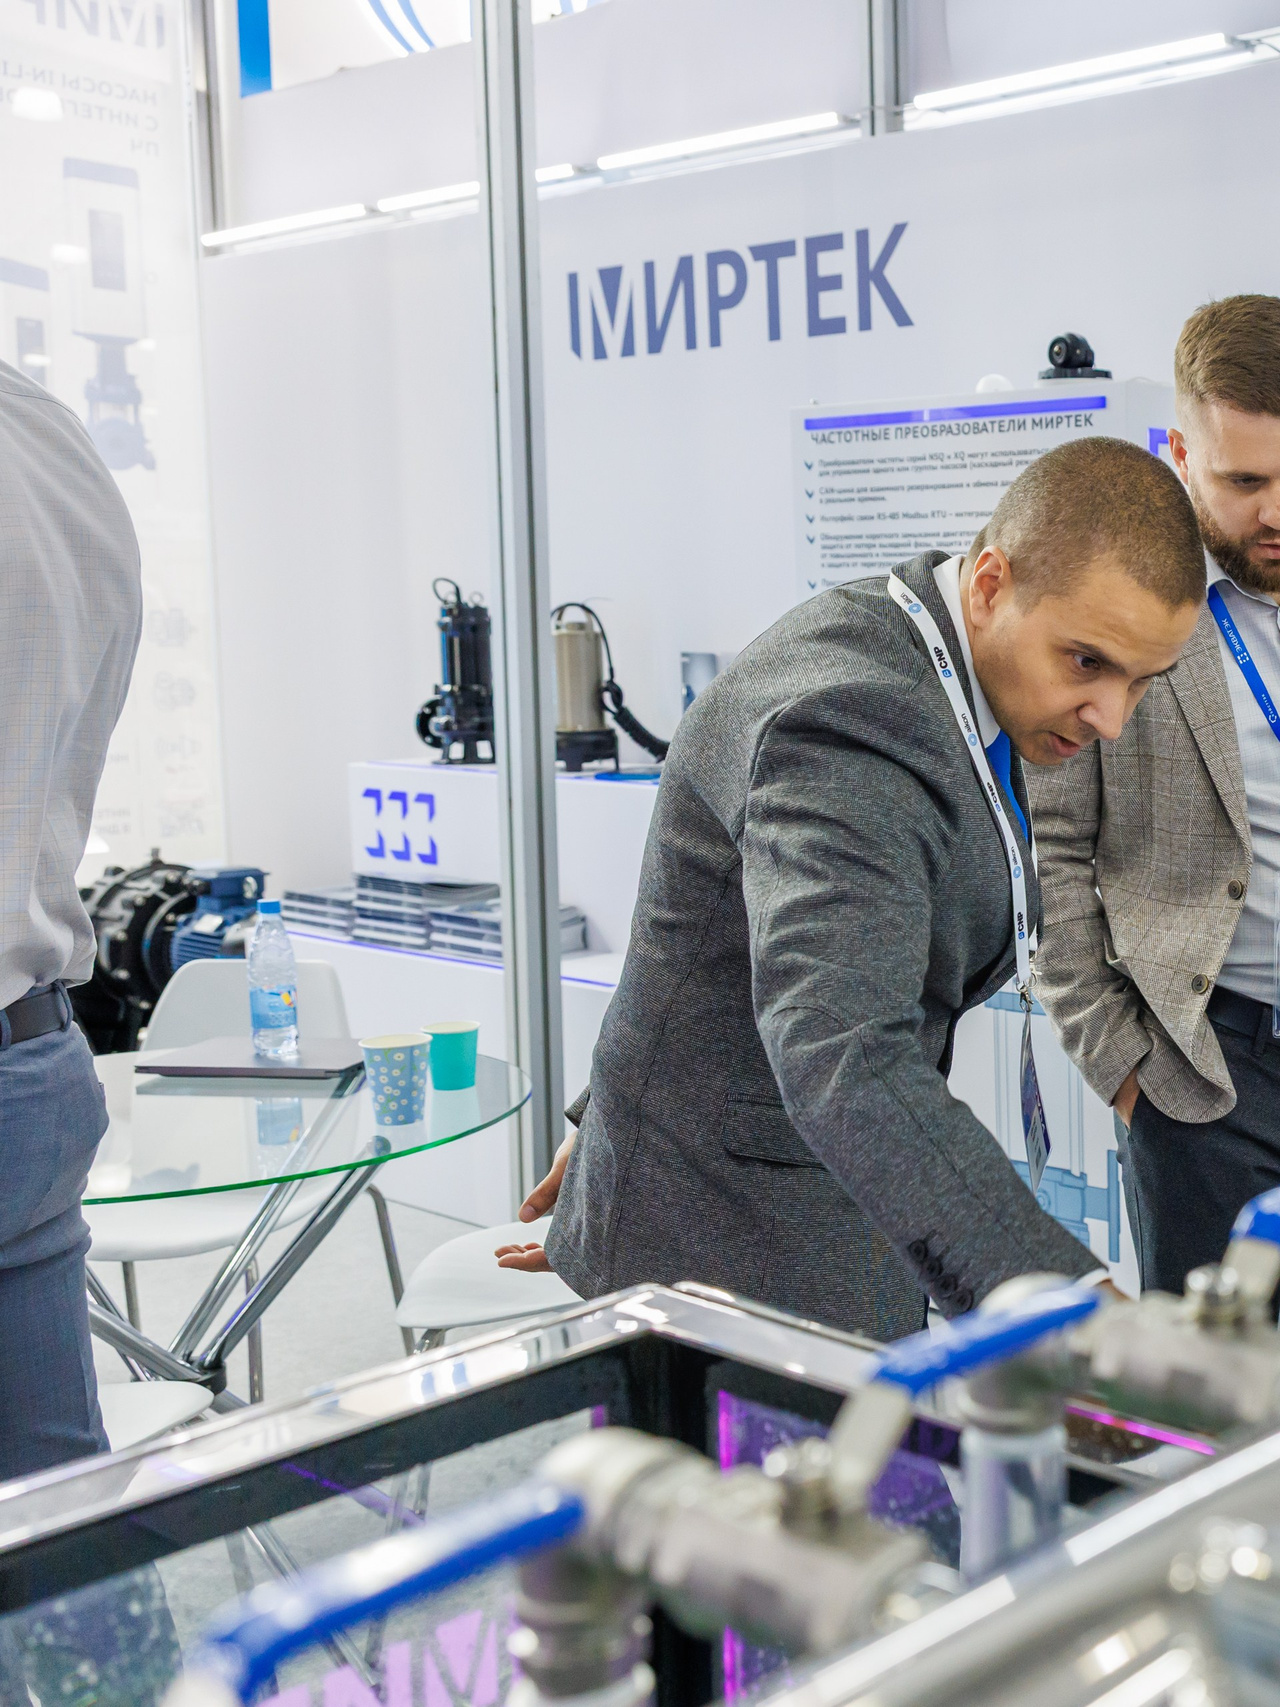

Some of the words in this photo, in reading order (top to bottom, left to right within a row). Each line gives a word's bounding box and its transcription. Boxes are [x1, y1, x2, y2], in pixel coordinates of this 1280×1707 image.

[567, 221, 914, 361] МИРТЕК
[811, 427, 890, 444] ЧАСТОТНЫЕ
[894, 419, 1027, 440] ПРЕОБРАЗОВАТЕЛИ
[1031, 413, 1094, 430] МИРТЕК
[1222, 618, 1243, 653] ЭКВАТЭК
[933, 646, 948, 669] CNP
[987, 781, 998, 803] CNP
